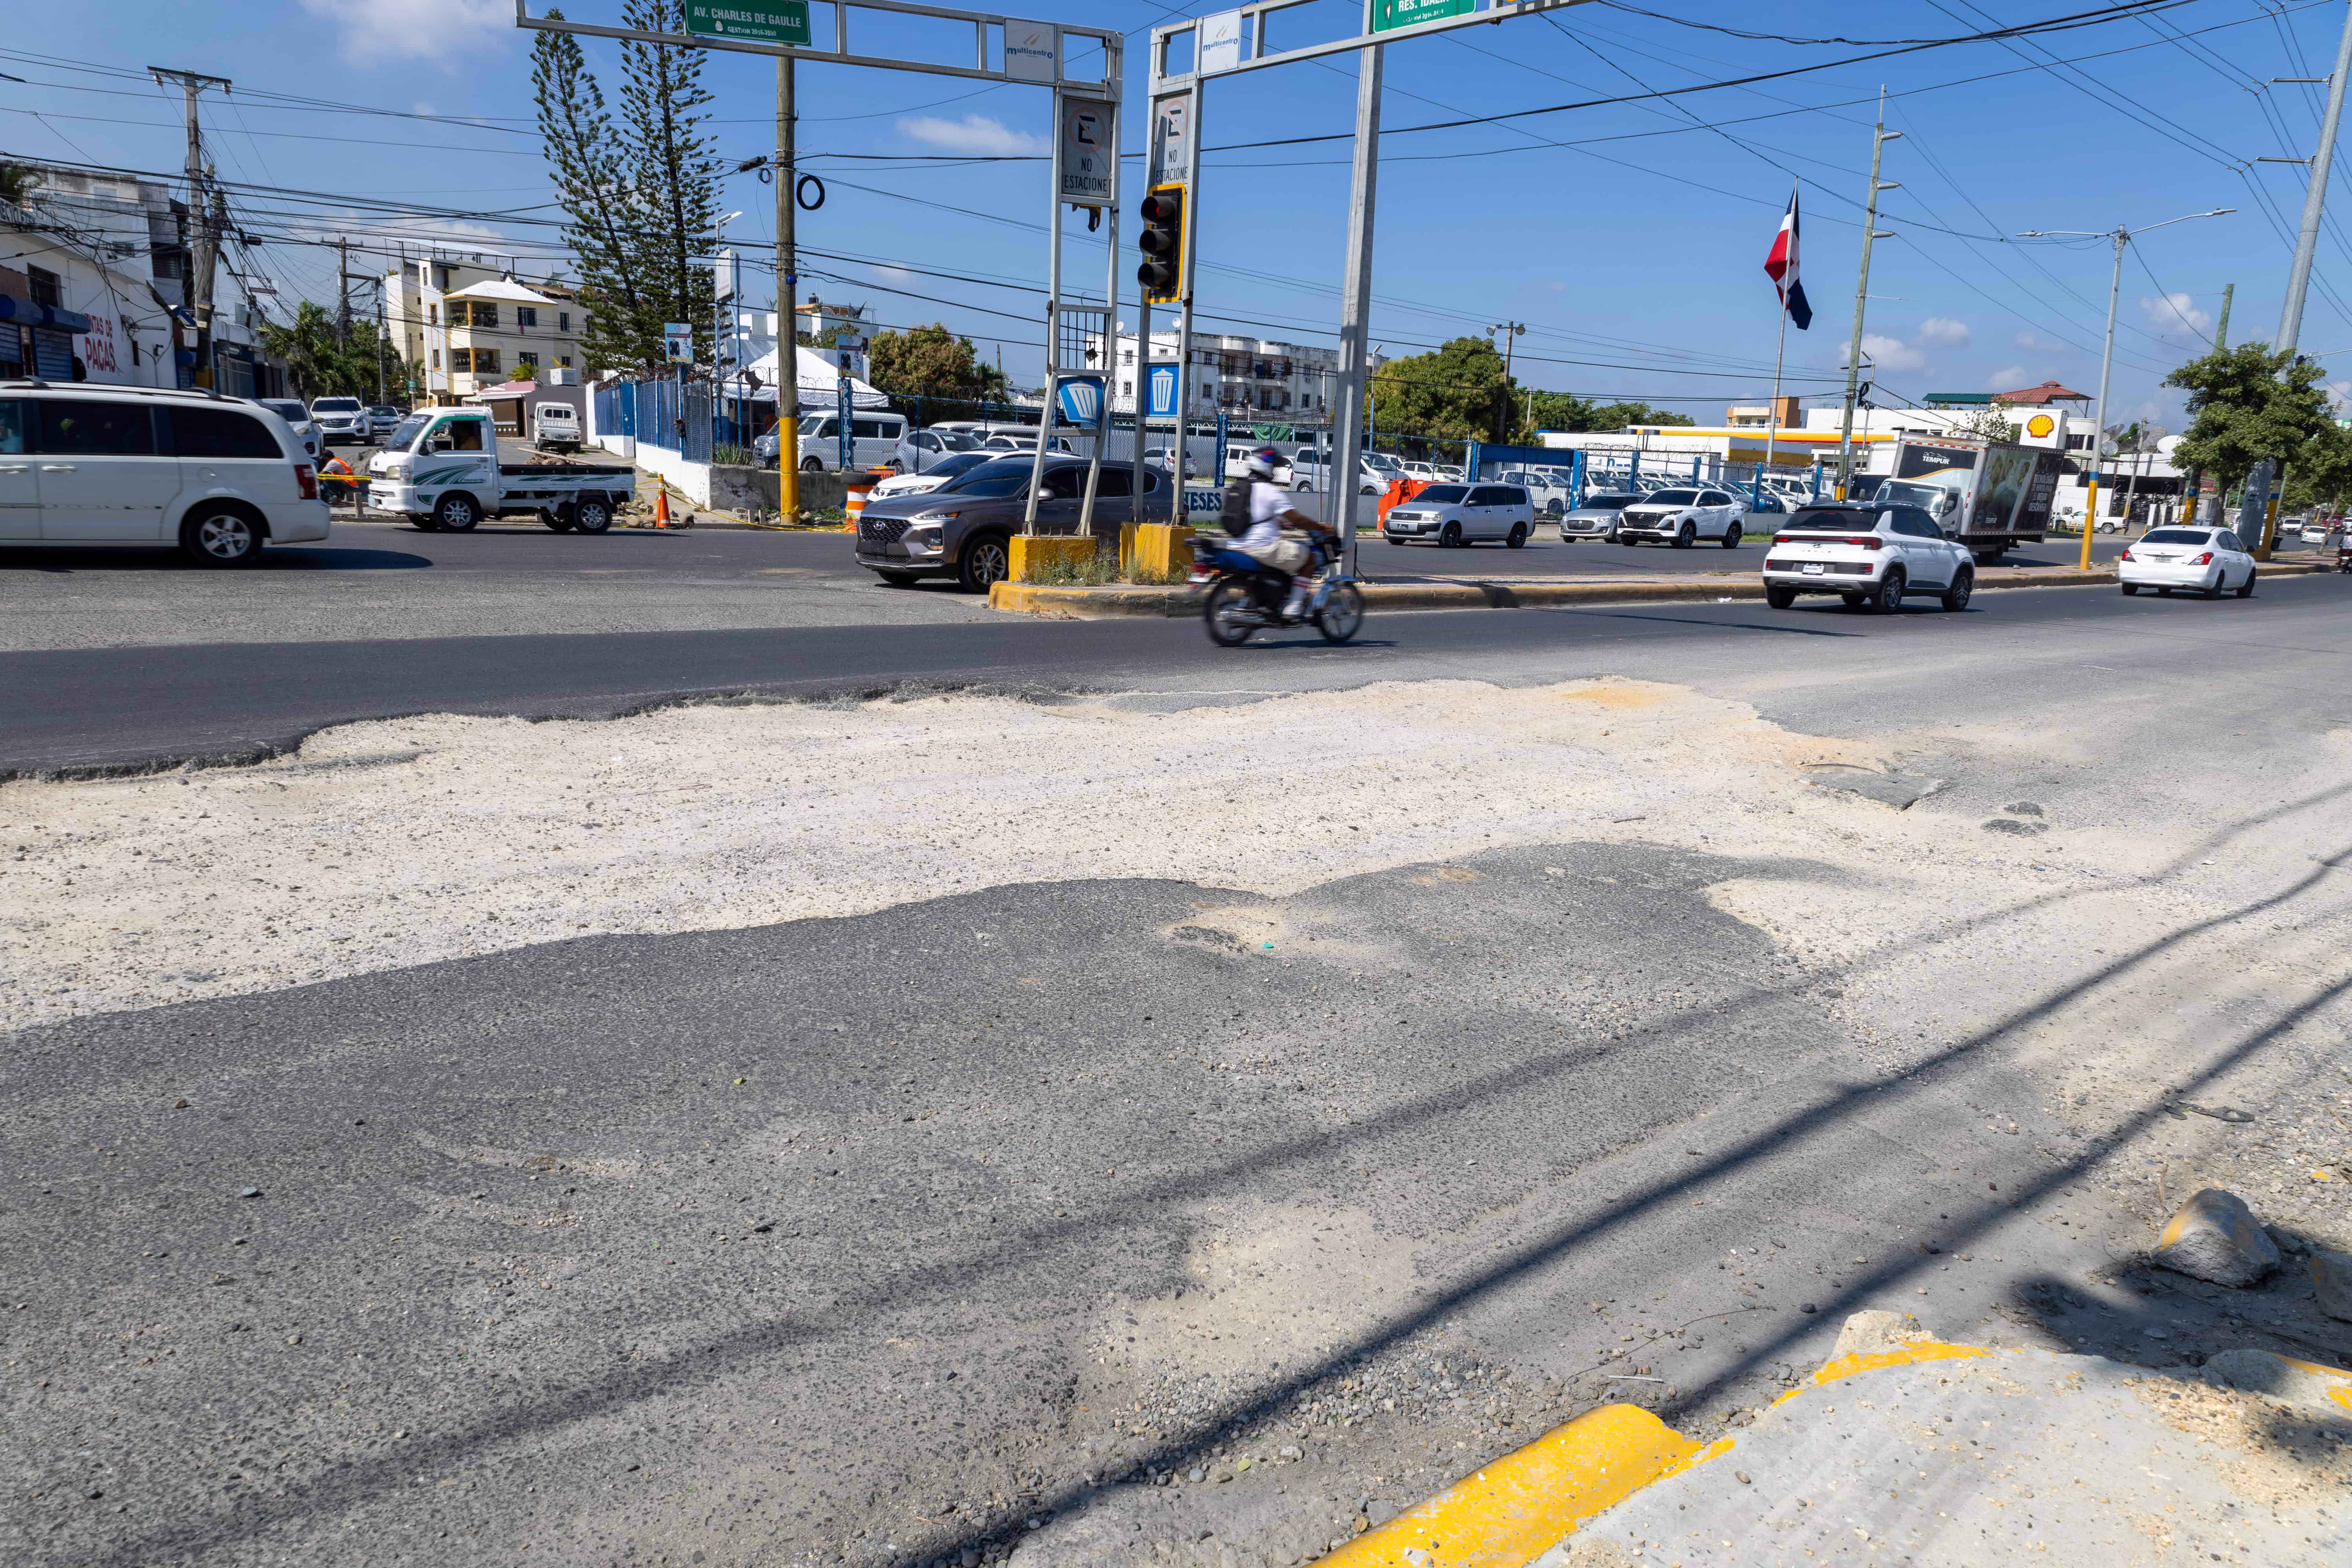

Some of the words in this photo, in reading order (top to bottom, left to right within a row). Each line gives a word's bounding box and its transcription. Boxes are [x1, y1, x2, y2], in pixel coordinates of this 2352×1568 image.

[1398, 0, 1417, 12] RES.
[694, 6, 708, 18] AV.
[711, 8, 752, 22] CHARLES
[754, 13, 766, 24] DE
[768, 15, 801, 27] GAULLE
[1203, 38, 1238, 52] multicentro
[1007, 47, 1053, 59] multicentro
[1169, 150, 1177, 163] NO
[1081, 157, 1092, 172] NO
[1156, 167, 1188, 183] ESTACIONE
[1064, 175, 1107, 192] ESTACIONE
[105, 319, 113, 338] DE
[85, 337, 116, 373] PACAS
[1922, 456, 1950, 465] TEMPUR
[2028, 503, 2047, 512] DESCANSO
